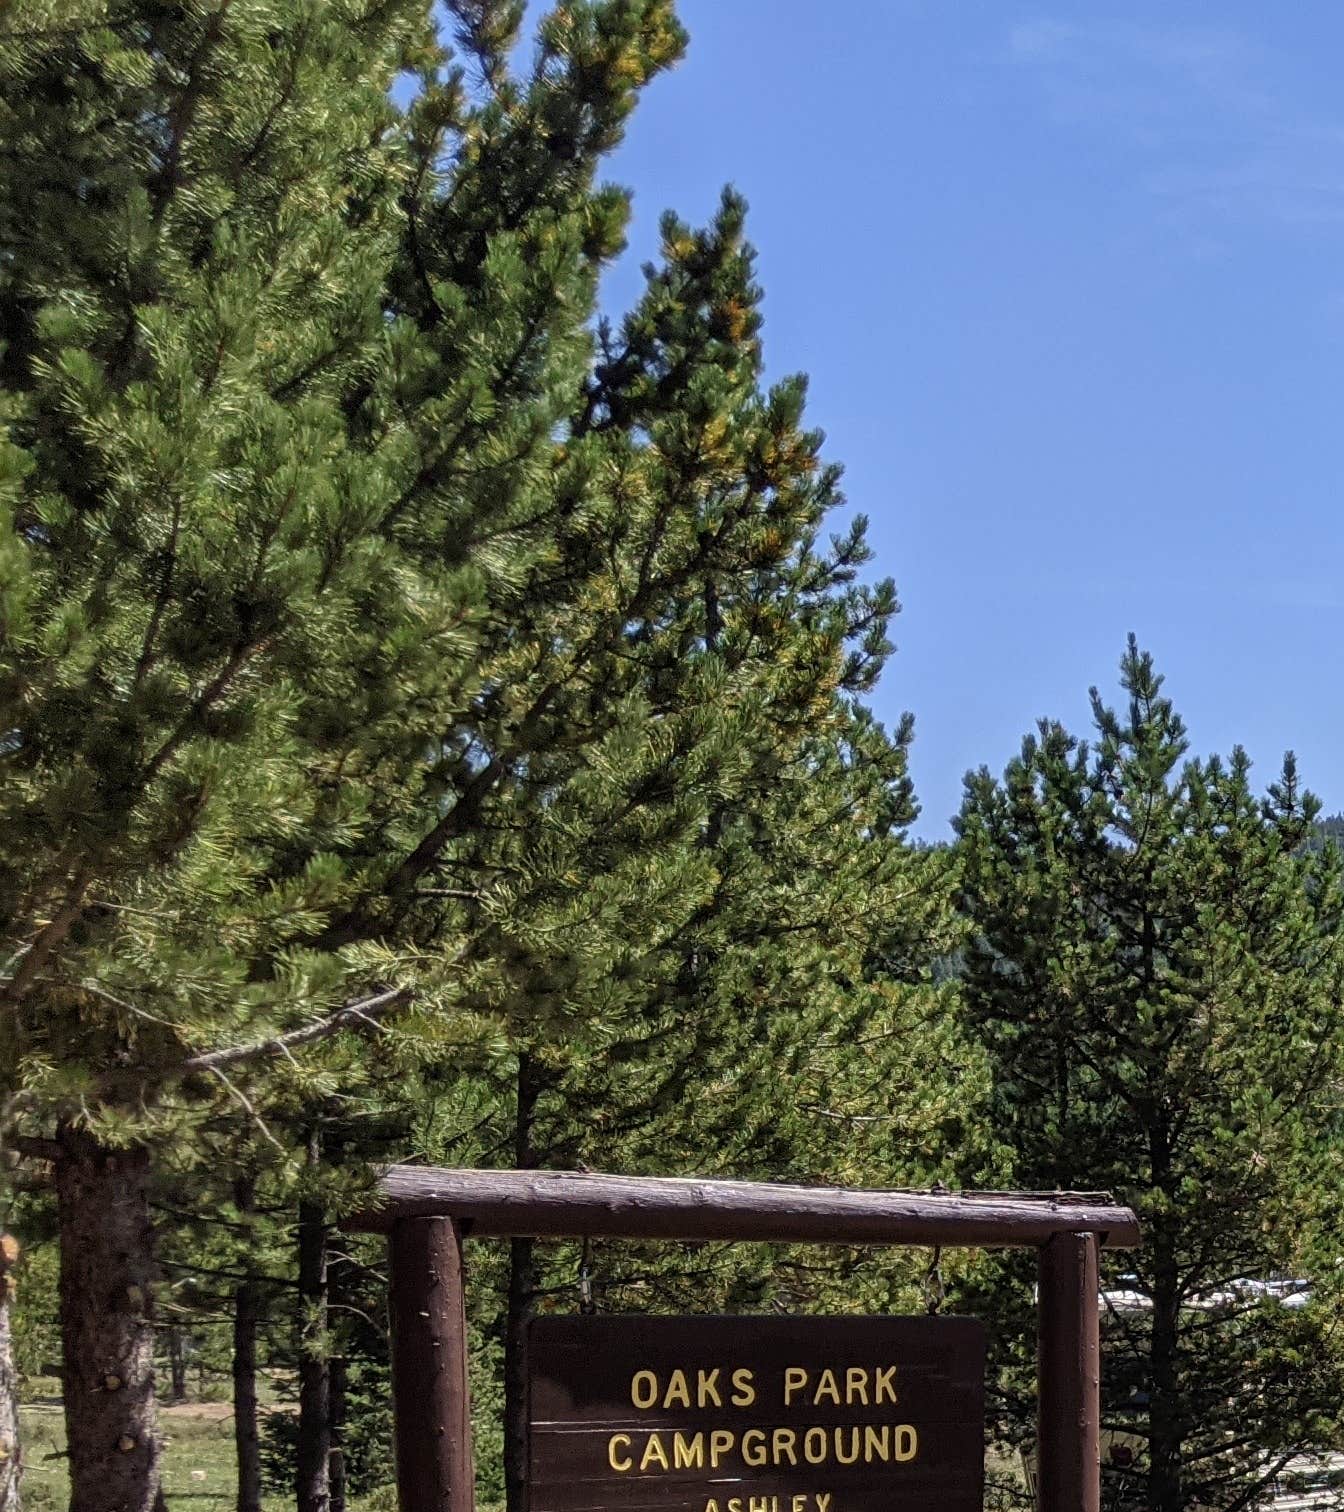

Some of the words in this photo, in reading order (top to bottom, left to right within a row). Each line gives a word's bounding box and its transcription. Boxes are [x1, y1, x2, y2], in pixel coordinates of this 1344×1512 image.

[632, 1369, 755, 1408] OAKS
[785, 1366, 896, 1405] PARK
[609, 1425, 917, 1472] CAMPGROUND
